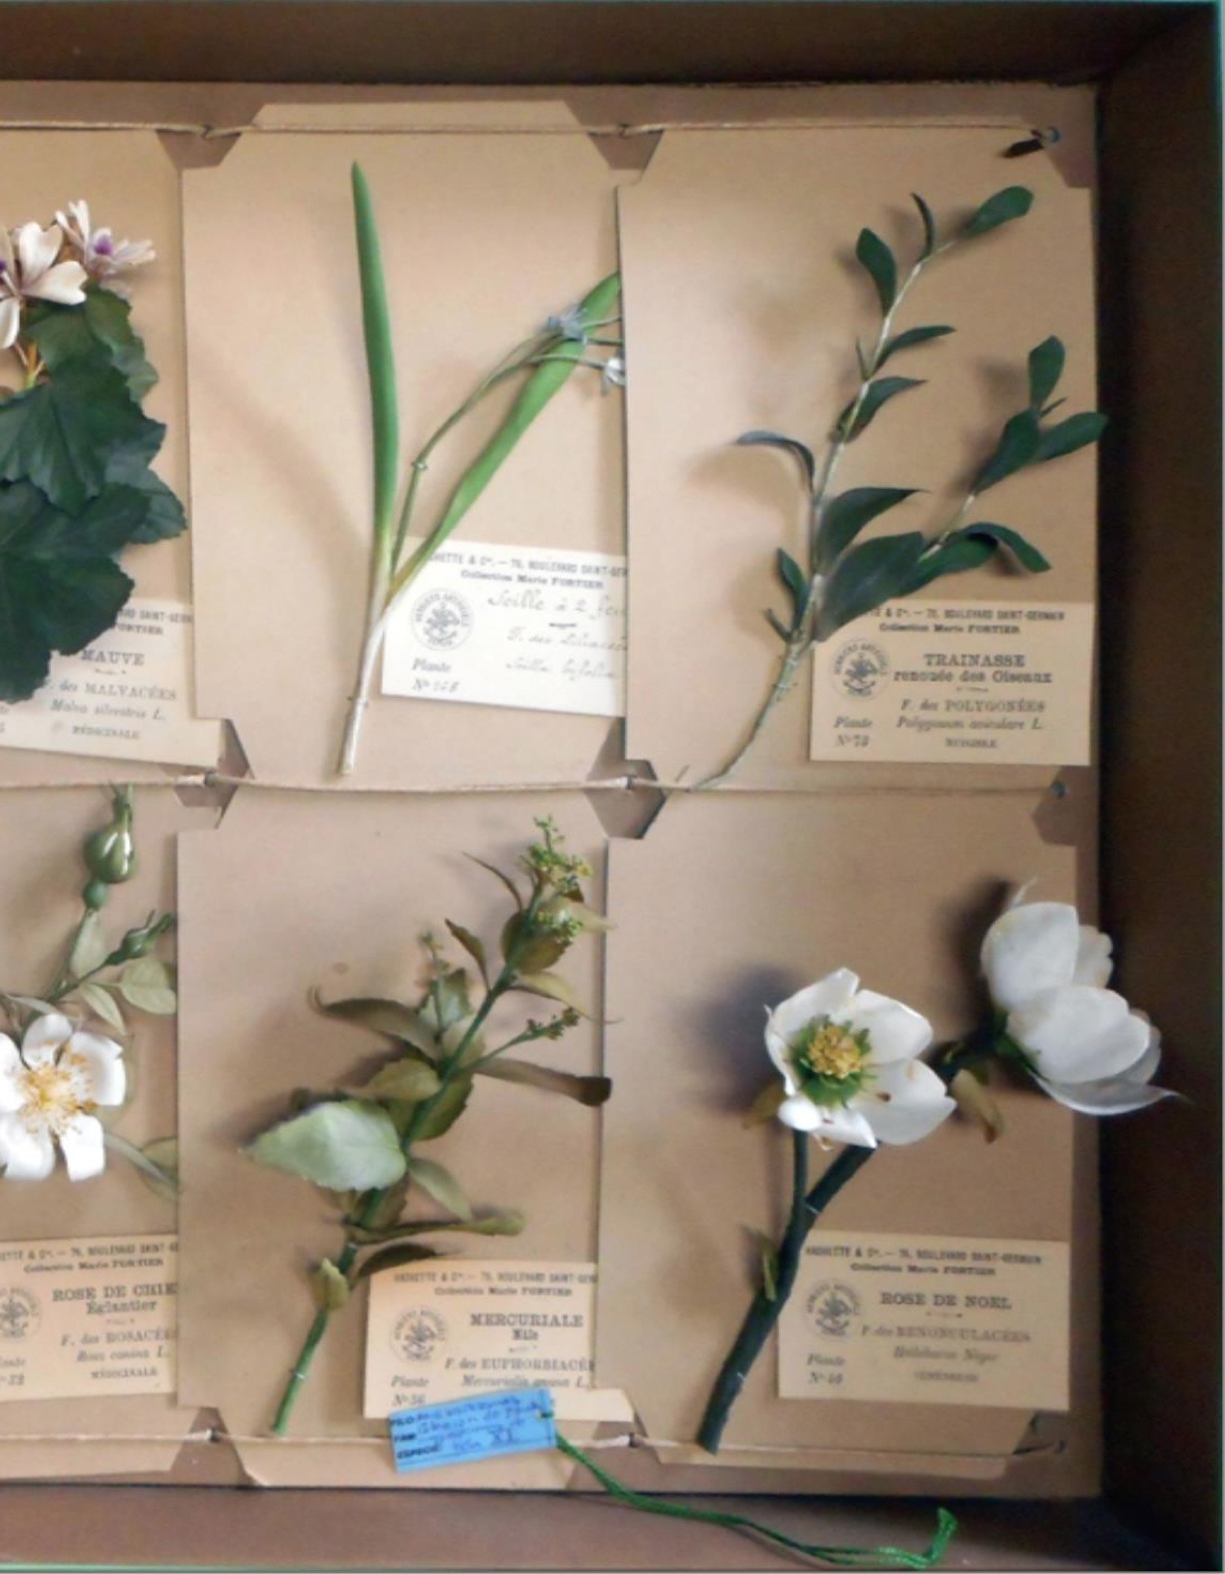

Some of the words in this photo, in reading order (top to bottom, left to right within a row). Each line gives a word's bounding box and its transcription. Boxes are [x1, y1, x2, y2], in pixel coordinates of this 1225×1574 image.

[551, 577, 604, 589] FORTIER
[967, 624, 1020, 634] FORTIER
[81, 650, 145, 667] MAUVE
[924, 654, 1026, 668] TRAINASSE
[959, 670, 986, 682] des
[992, 670, 1053, 683] Oiseaux
[85, 682, 177, 701] MALVACÉES
[944, 698, 1046, 712] POLYGONÉES
[943, 1266, 996, 1276] FORTIER
[52, 1288, 97, 1302] ROSE
[103, 1285, 128, 1299] DE
[881, 1292, 926, 1306] ROSE
[933, 1293, 957, 1307] DE
[470, 1312, 584, 1328] MERCURIALE
